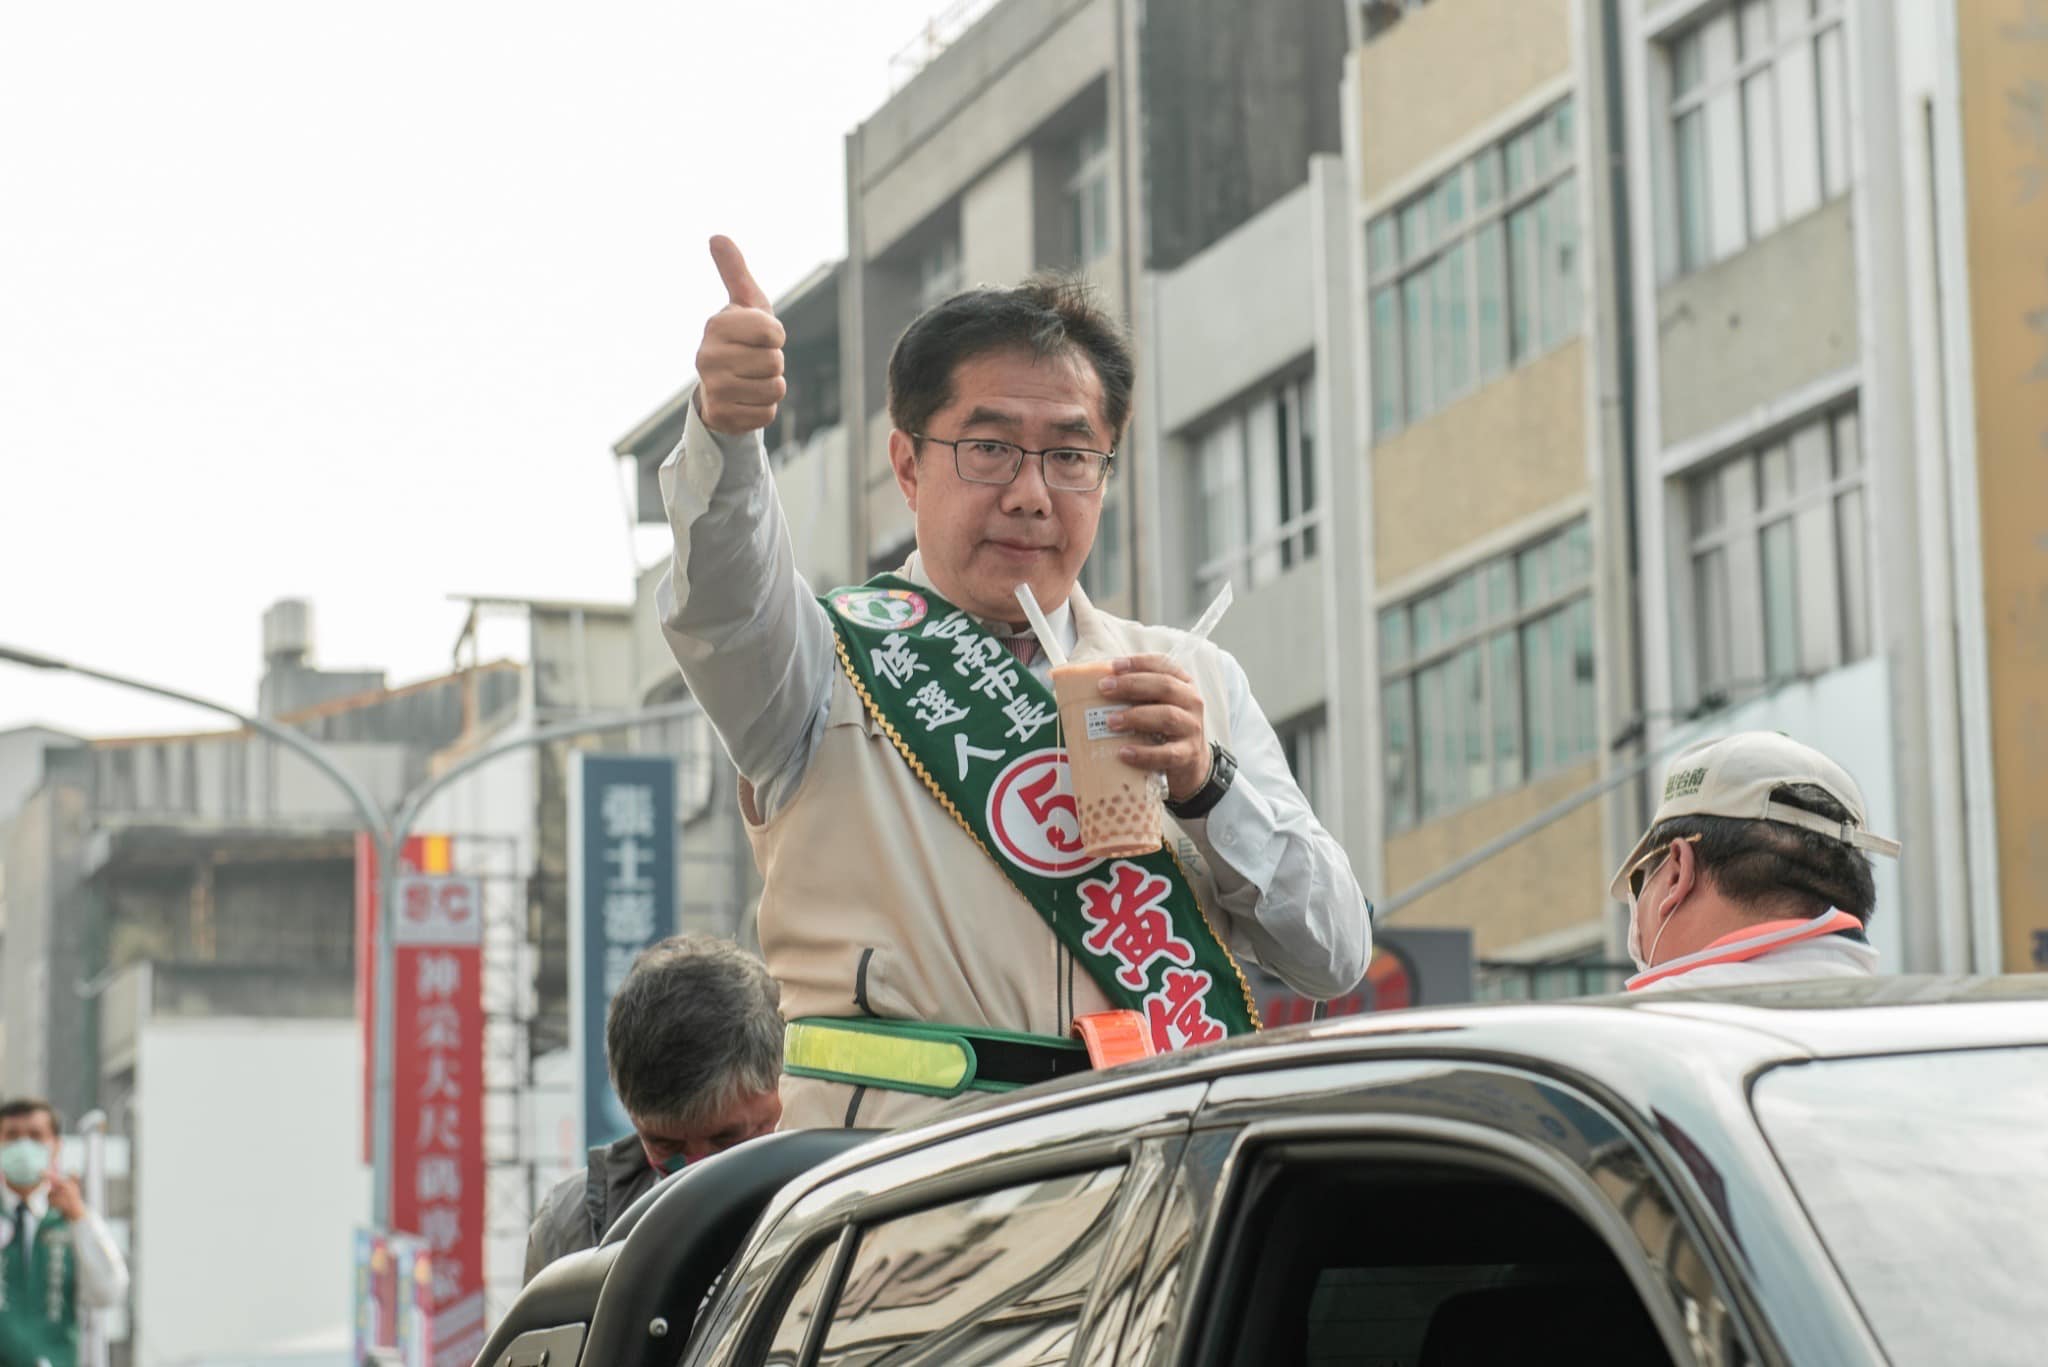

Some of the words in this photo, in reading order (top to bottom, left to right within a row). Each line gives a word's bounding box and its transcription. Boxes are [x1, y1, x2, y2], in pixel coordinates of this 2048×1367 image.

[870, 632, 1006, 782] 候選人
[921, 609, 1058, 743] 台南市長
[1017, 768, 1085, 853] 5
